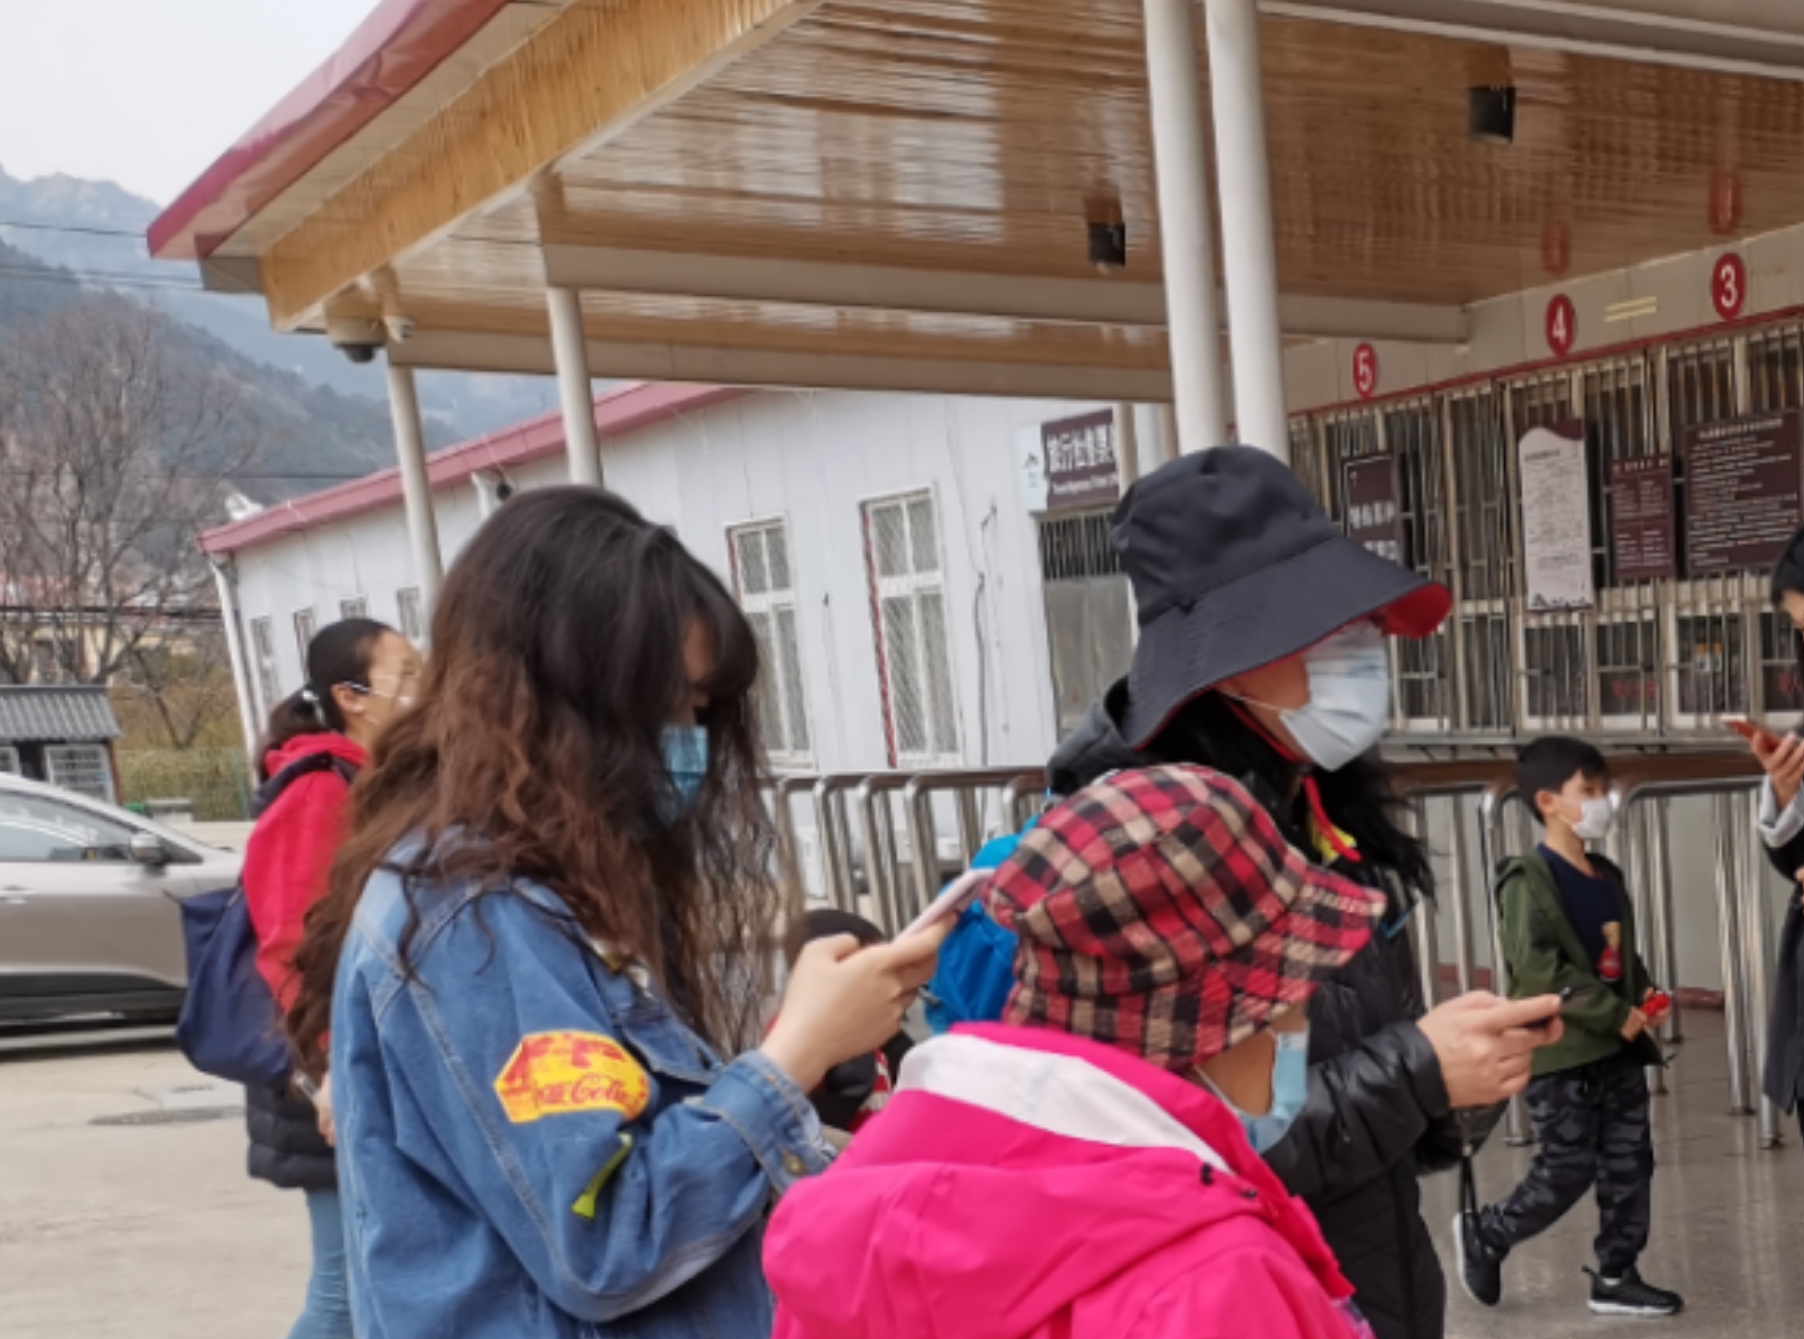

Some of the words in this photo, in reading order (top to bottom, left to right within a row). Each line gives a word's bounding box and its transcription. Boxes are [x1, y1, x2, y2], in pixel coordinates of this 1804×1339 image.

[1720, 264, 1738, 310] 3
[1552, 303, 1567, 346] 4
[1358, 350, 1373, 392] 5
